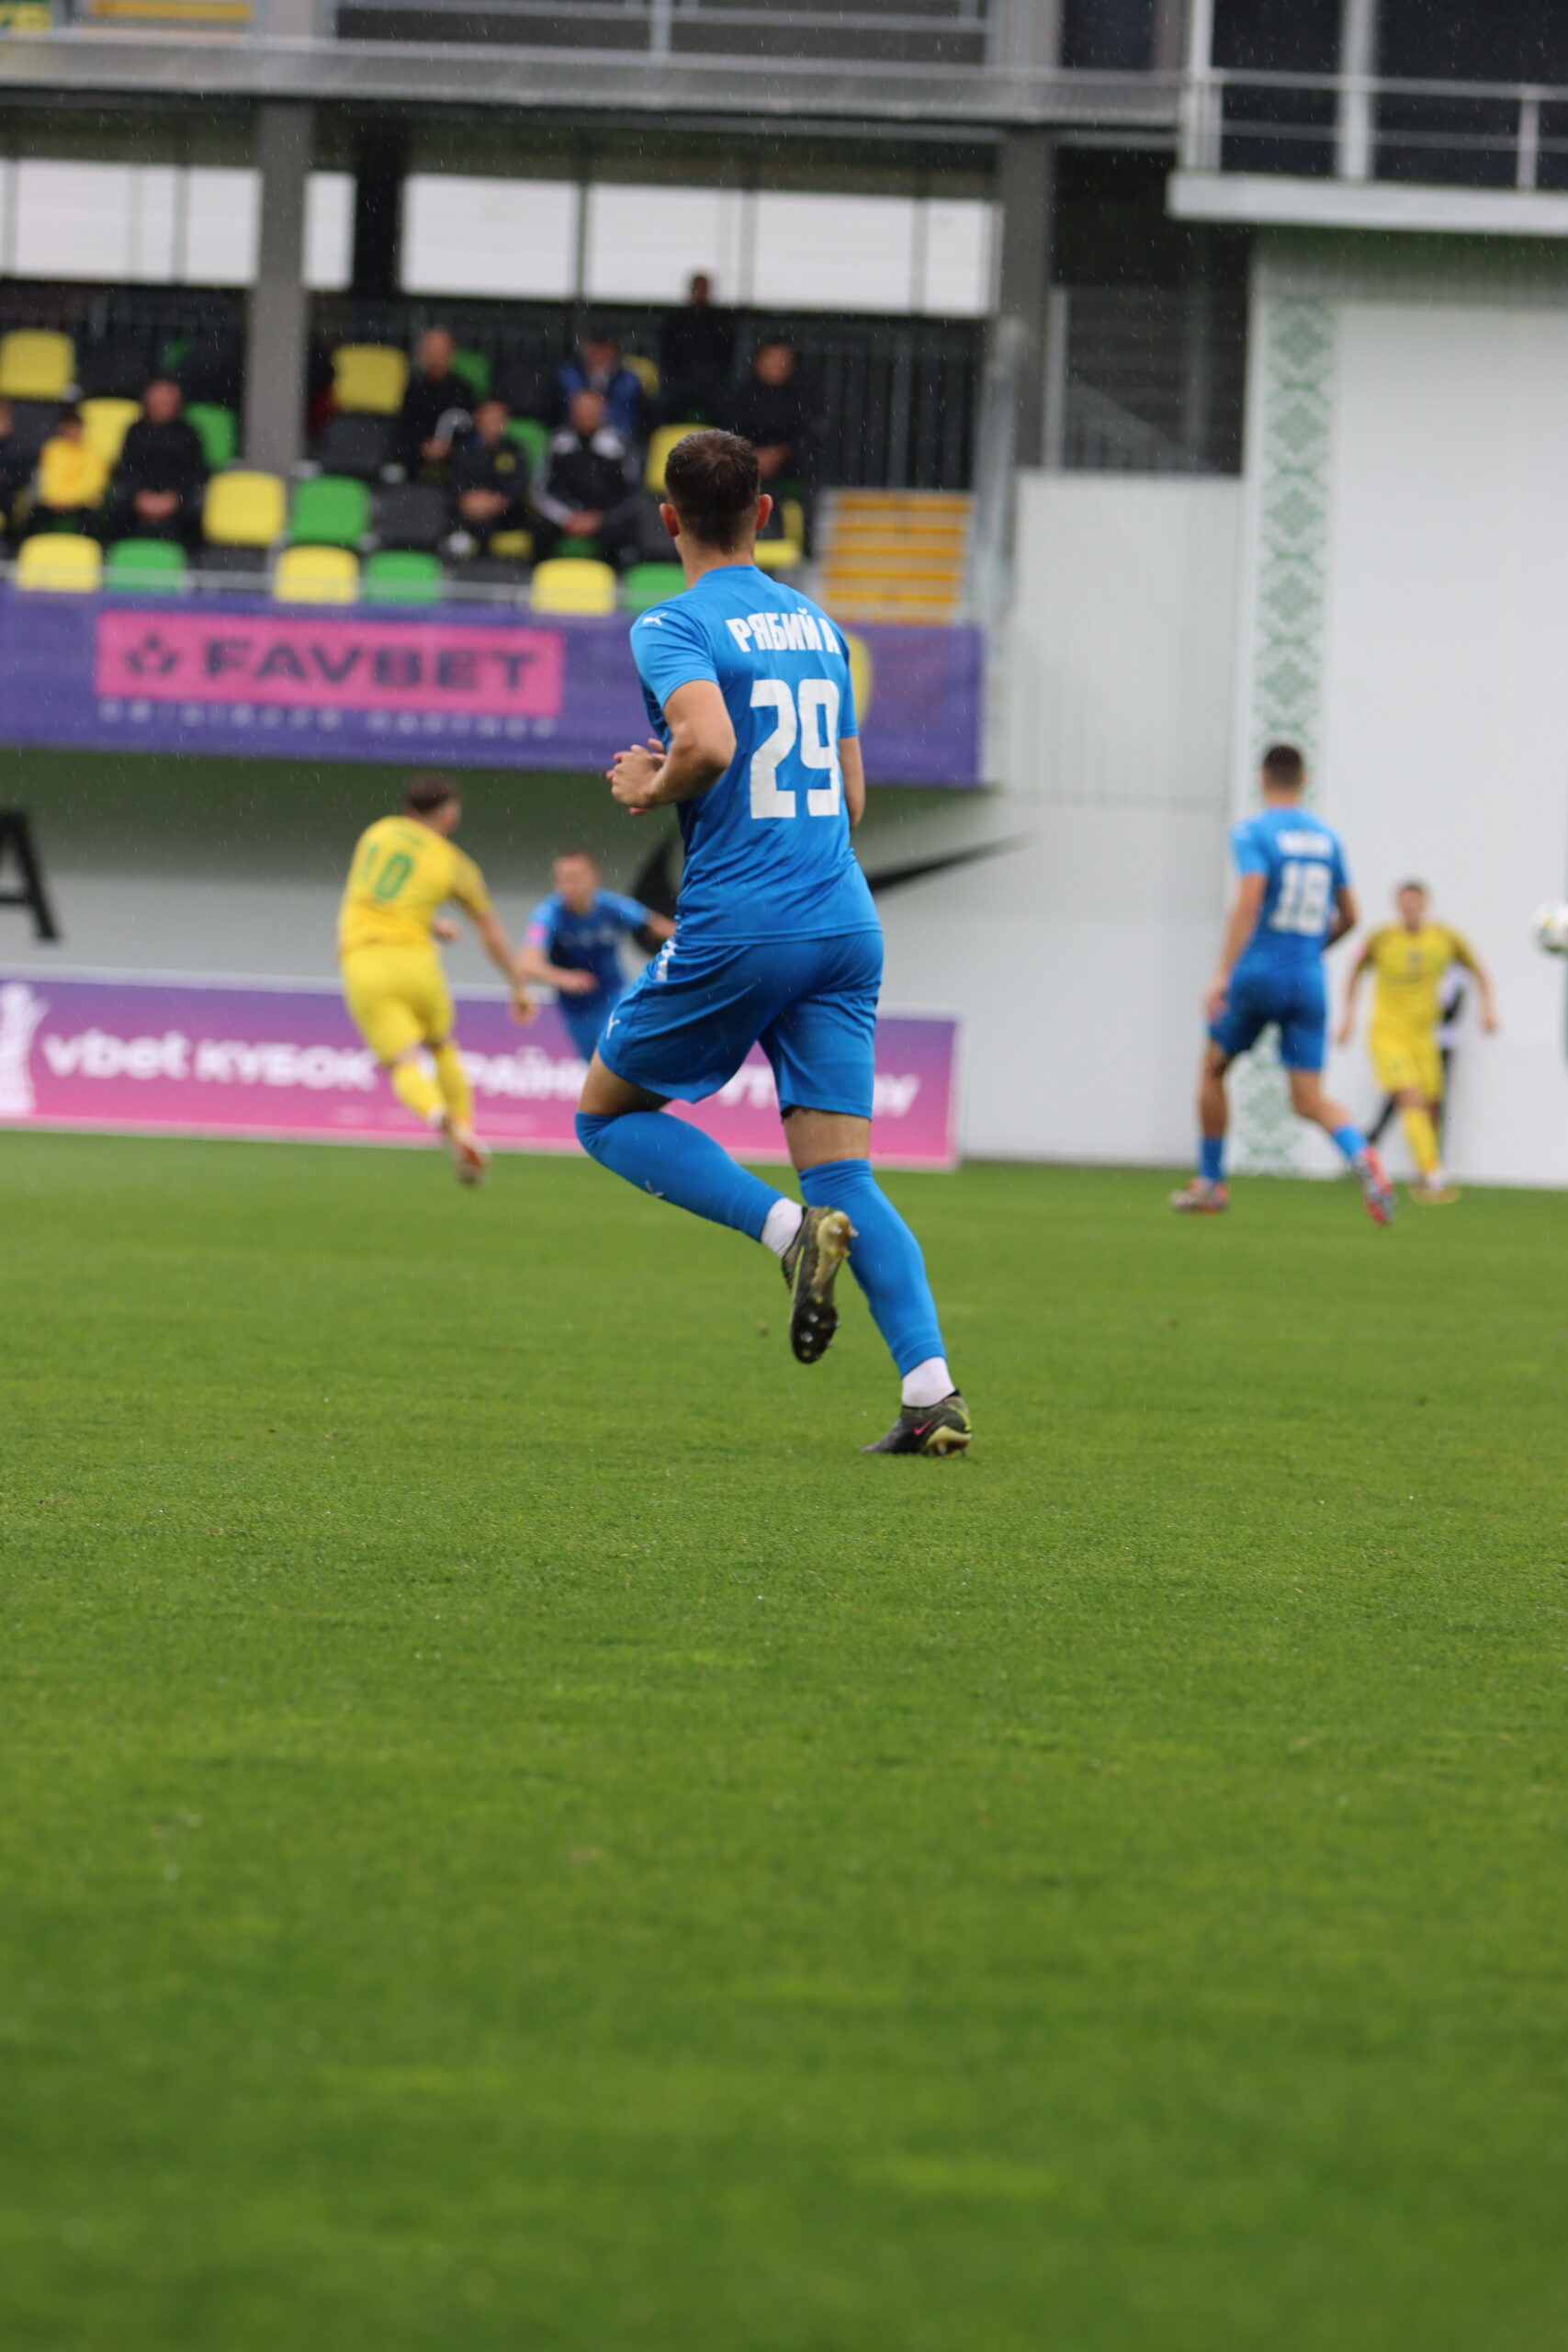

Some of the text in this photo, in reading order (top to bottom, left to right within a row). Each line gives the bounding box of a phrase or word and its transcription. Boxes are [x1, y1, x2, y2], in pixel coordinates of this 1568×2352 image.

[726, 607, 823, 652] РЯБИЙ
[205, 638, 536, 692] FAVBET
[750, 678, 840, 820] 29
[358, 841, 414, 899] 10
[41, 1026, 190, 1080] vbet
[194, 1038, 377, 1092] КУБОК
